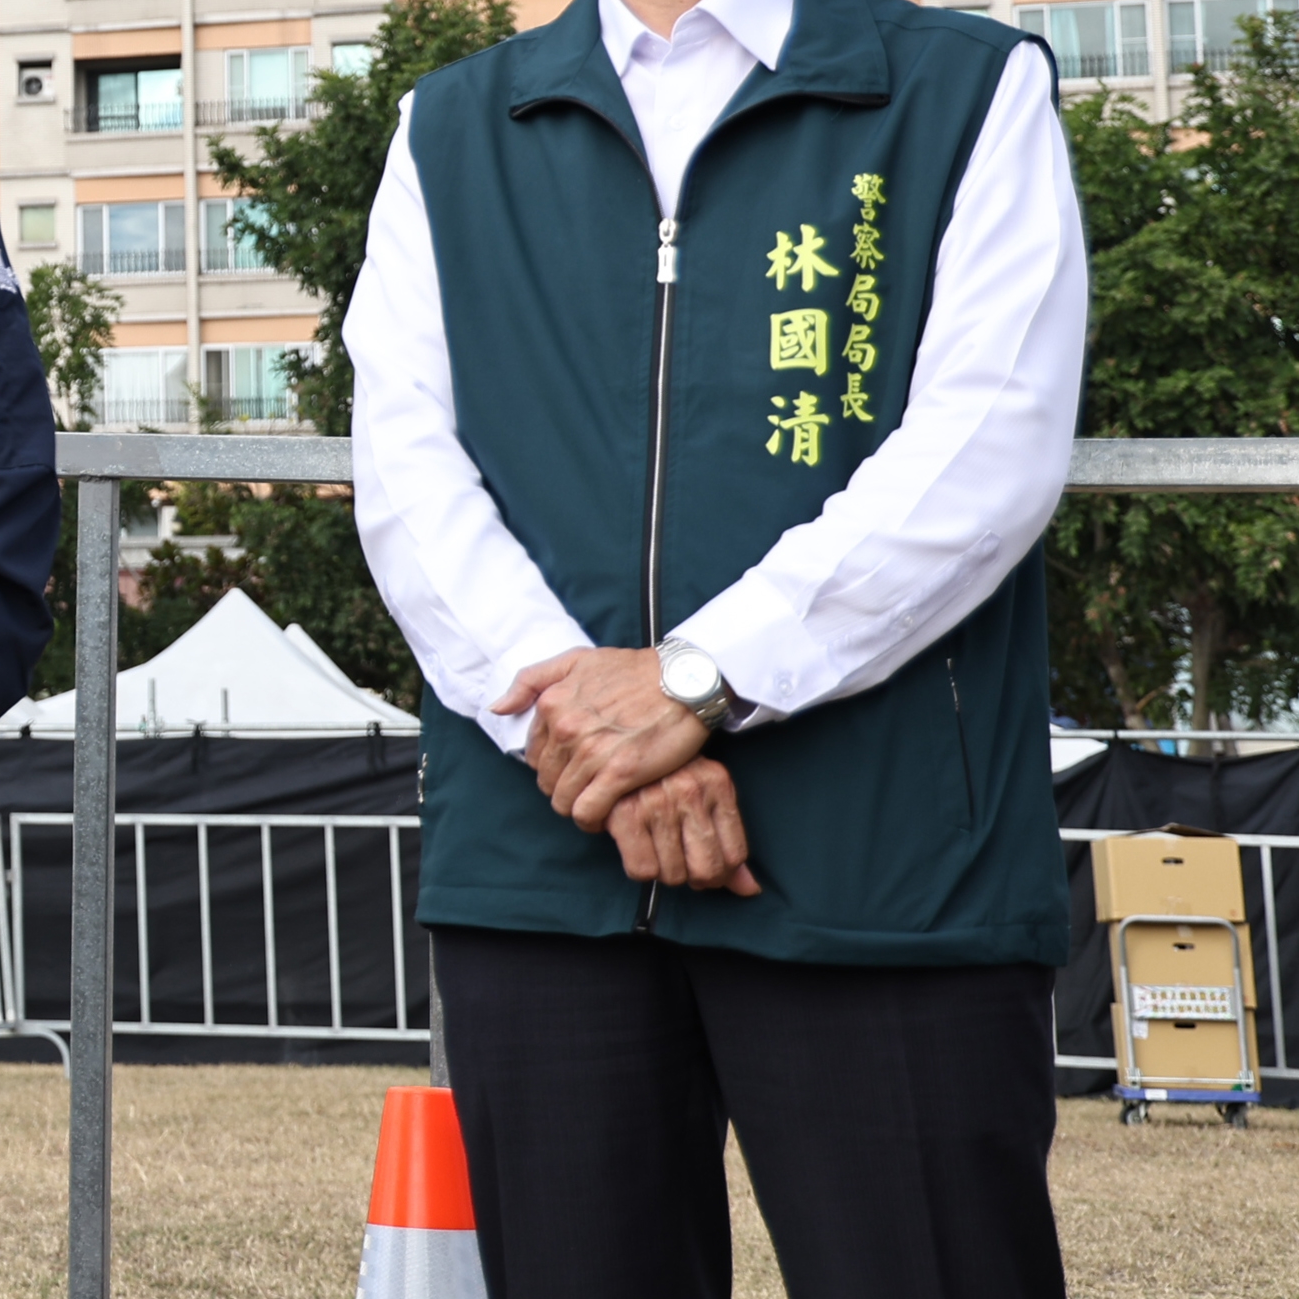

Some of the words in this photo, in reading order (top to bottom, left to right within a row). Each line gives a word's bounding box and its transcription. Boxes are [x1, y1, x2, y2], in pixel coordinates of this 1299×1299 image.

[765, 223, 839, 467] 林國清
[840, 173, 886, 422] 警察局局長
